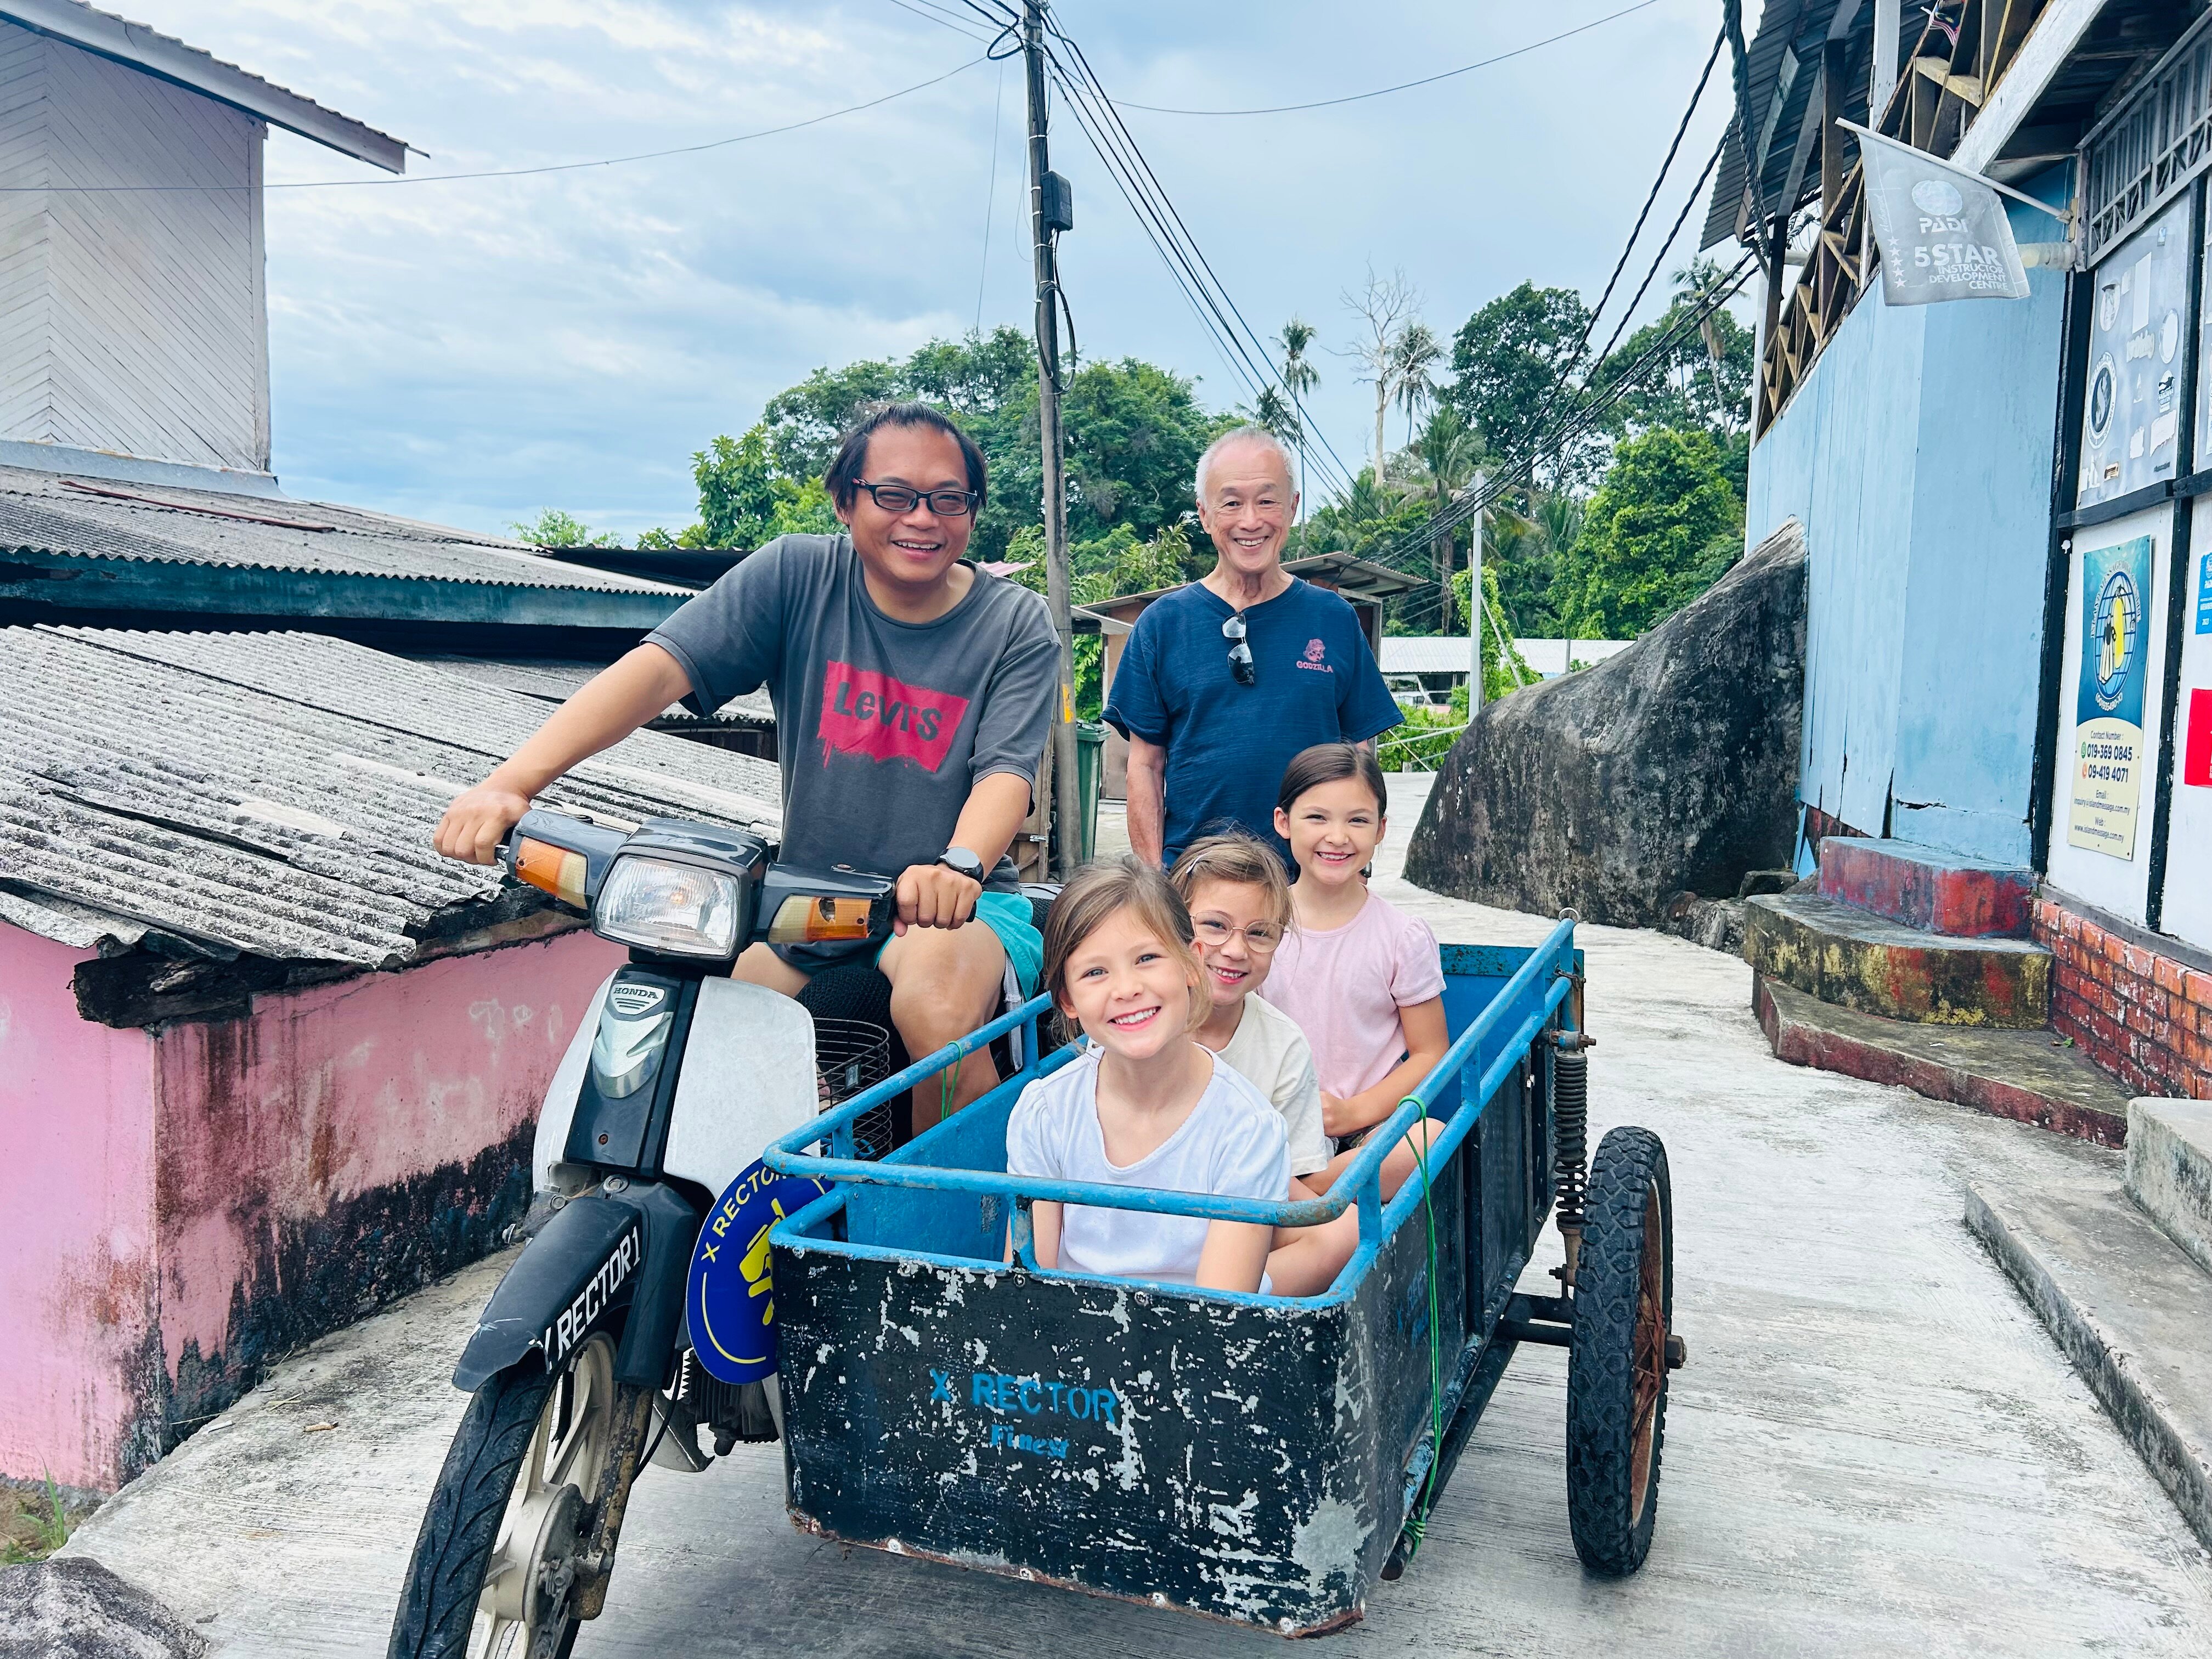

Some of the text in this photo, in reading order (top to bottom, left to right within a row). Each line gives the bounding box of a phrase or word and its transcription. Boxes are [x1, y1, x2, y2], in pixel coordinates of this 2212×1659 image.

[1919, 217, 1968, 233] PADI
[1938, 263, 2004, 274] INSTRUCTOR
[1929, 272, 2006, 284] DEVELOPMENT
[1968, 280, 2009, 291] CENTRE
[1296, 660, 1334, 673] GODZILLA
[2087, 743, 2133, 761] 019-369 0845
[2088, 764, 2129, 783] 09-419 4071
[613, 988, 658, 999] HONDA
[701, 1242, 720, 1263] X
[929, 1368, 1118, 1424] X RECTOR
